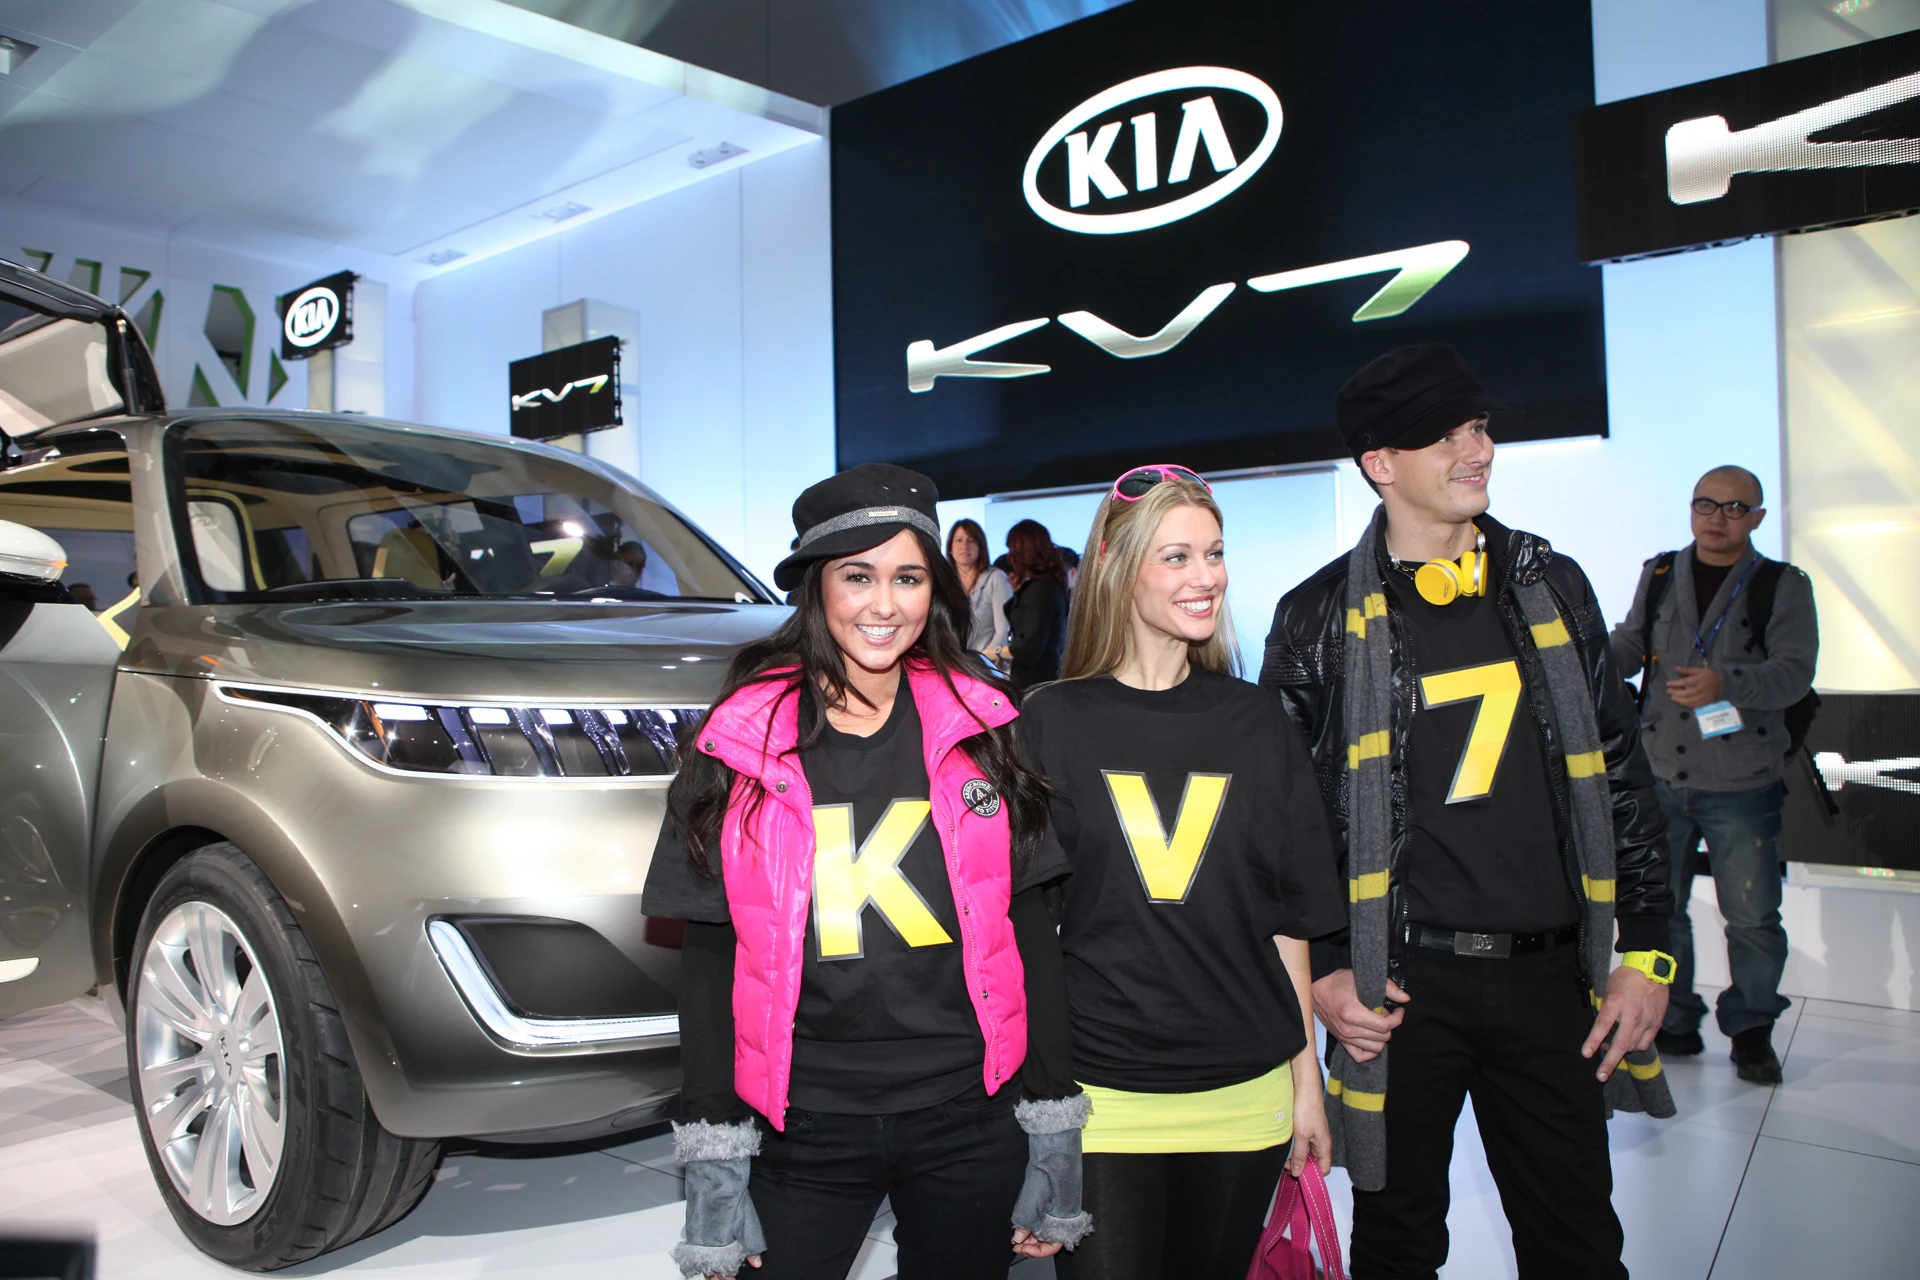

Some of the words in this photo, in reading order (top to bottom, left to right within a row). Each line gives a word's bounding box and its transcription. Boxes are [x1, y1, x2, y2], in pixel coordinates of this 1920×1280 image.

[1064, 95, 1238, 208] KIA
[906, 239, 1471, 394] KV7
[511, 374, 609, 412] KV7
[1419, 659, 1523, 804] 7
[809, 798, 959, 961] K
[1101, 769, 1233, 903] V
